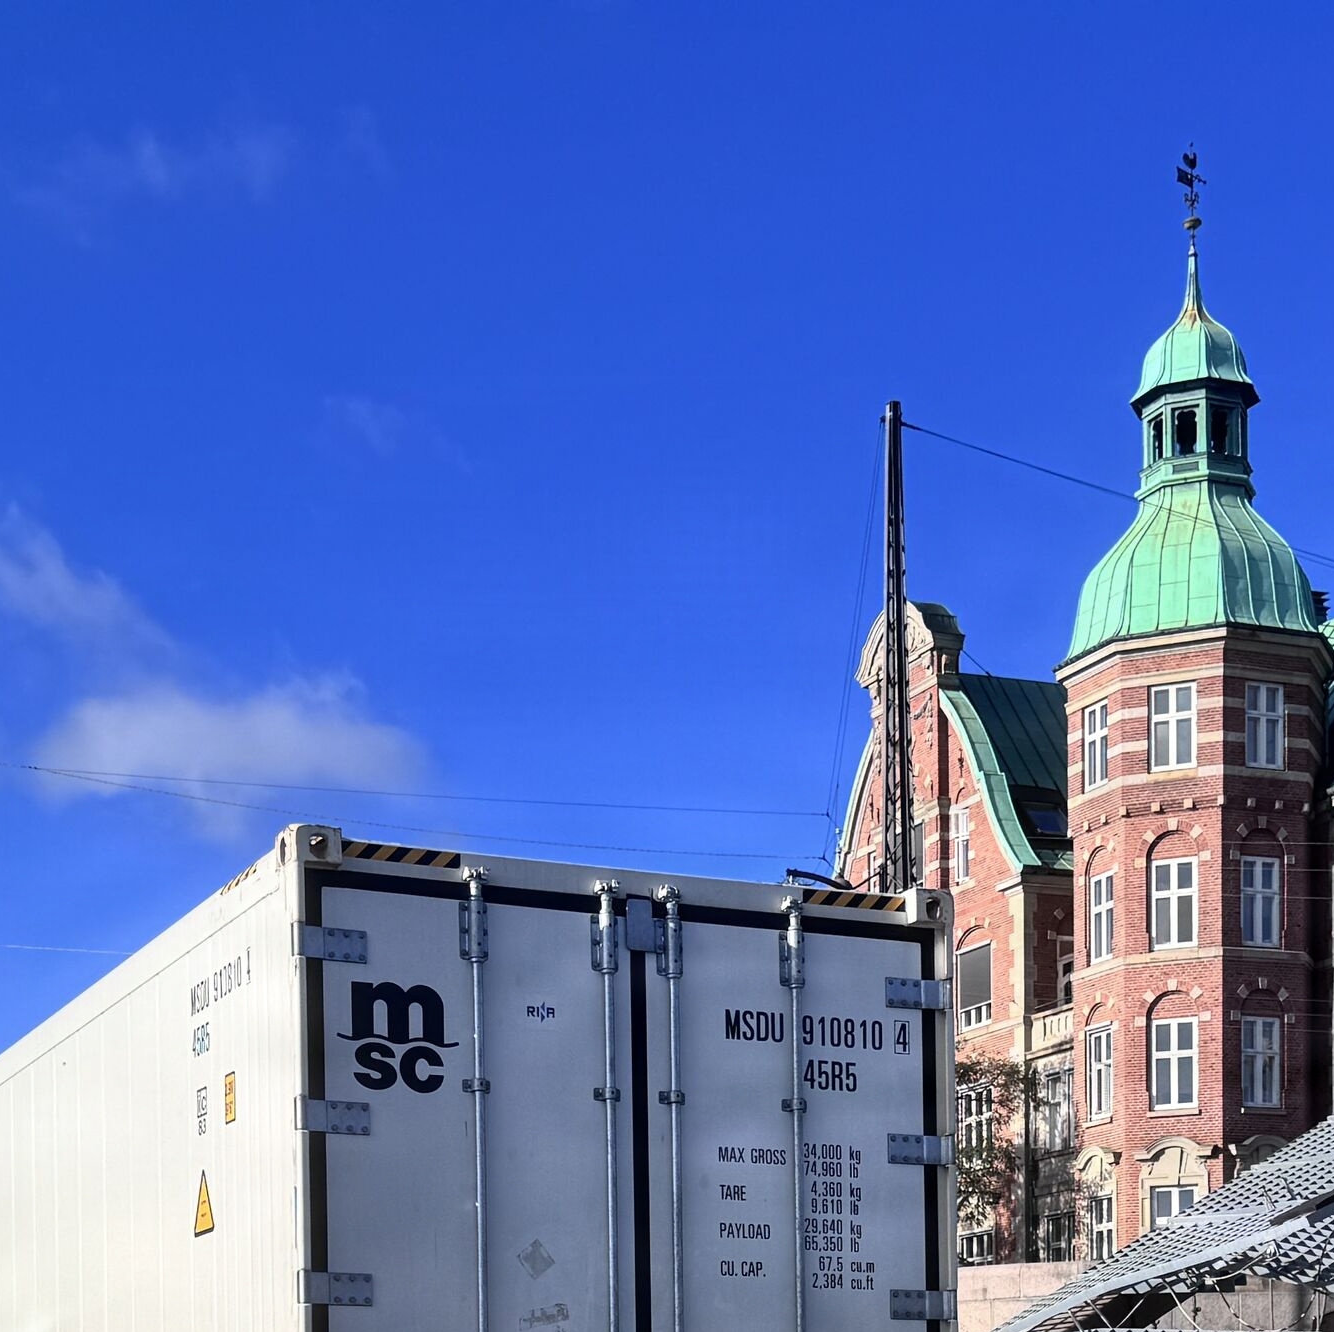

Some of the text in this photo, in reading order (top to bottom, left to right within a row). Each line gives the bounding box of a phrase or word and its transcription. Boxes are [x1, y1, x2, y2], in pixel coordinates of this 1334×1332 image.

[724, 1008, 909, 1053] MSDU 910810 4
[803, 1059, 858, 1093] 45R5
[718, 1146, 746, 1163] MAX
[750, 1148, 787, 1166] GROSS
[849, 1145, 861, 1165] kg
[849, 1162, 859, 1179] lb
[719, 1184, 747, 1201] TARE
[849, 1182, 862, 1202] kg
[849, 1199, 859, 1216] lb
[719, 1222, 771, 1240] PAYLOAD
[850, 1220, 862, 1240] kg
[850, 1236, 860, 1253] lb
[720, 1255, 875, 1278] CU. CAP. 67.5 cu.m
[850, 1274, 875, 1291] cu.ft
